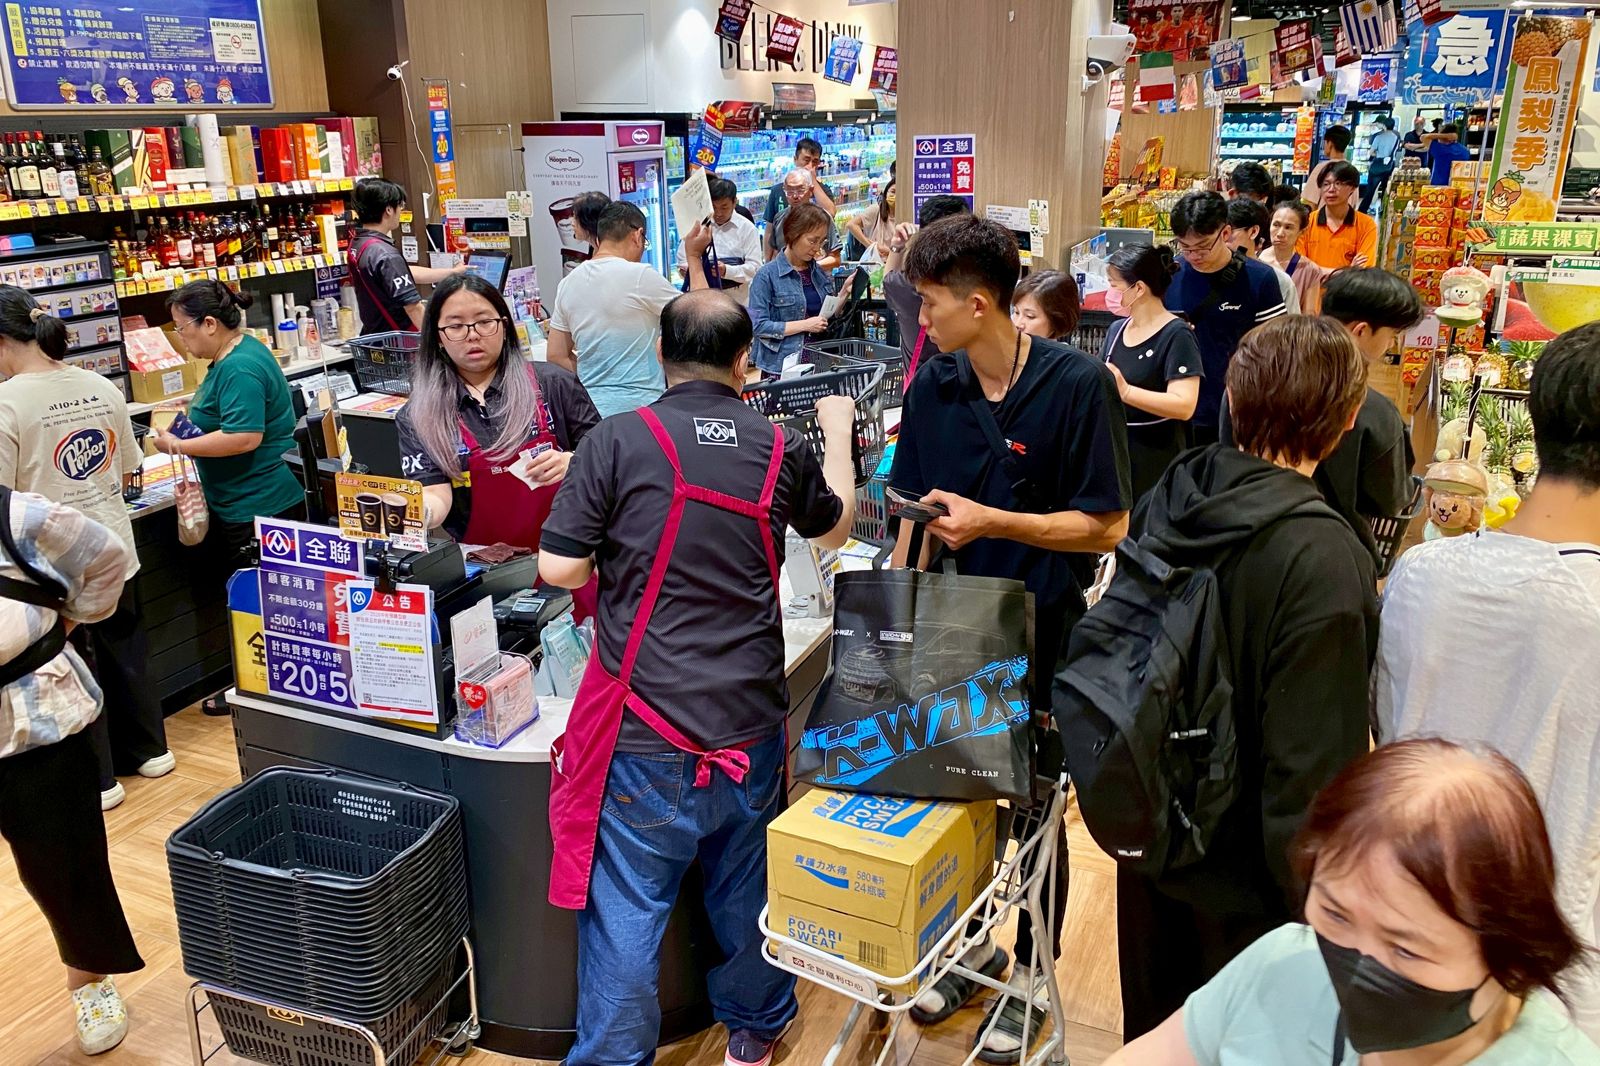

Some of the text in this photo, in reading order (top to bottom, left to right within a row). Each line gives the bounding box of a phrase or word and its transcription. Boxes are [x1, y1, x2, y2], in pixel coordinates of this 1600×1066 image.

[1436, 14, 1495, 76] 急
[1511, 56, 1563, 171] 鳳梨季
[697, 149, 716, 164] 200
[942, 141, 969, 152] 全聯
[957, 161, 971, 189] 免費
[1509, 229, 1595, 248] 蔬果裸賣
[393, 274, 413, 290] PX
[1417, 335, 1433, 346] 120
[73, 436, 93, 456] Dr
[402, 453, 425, 477] PX
[305, 538, 351, 565] 全聯
[268, 572, 315, 591] 顧客消費
[268, 593, 324, 611] 不限金額30分鐘
[382, 594, 411, 609] 公告
[270, 613, 326, 634] 滿500元1小時
[271, 640, 343, 664] 計時費率每小時
[272, 663, 280, 681] 平日
[281, 660, 318, 696] 20
[945, 766, 999, 778] PURE CLEAN
[794, 854, 848, 875] 寶礦力水得
[854, 881, 887, 899] 24瓶裝
[788, 916, 843, 942] POCARI
[788, 926, 837, 950] SWEAT
[806, 962, 864, 992] 全聯福利中心
